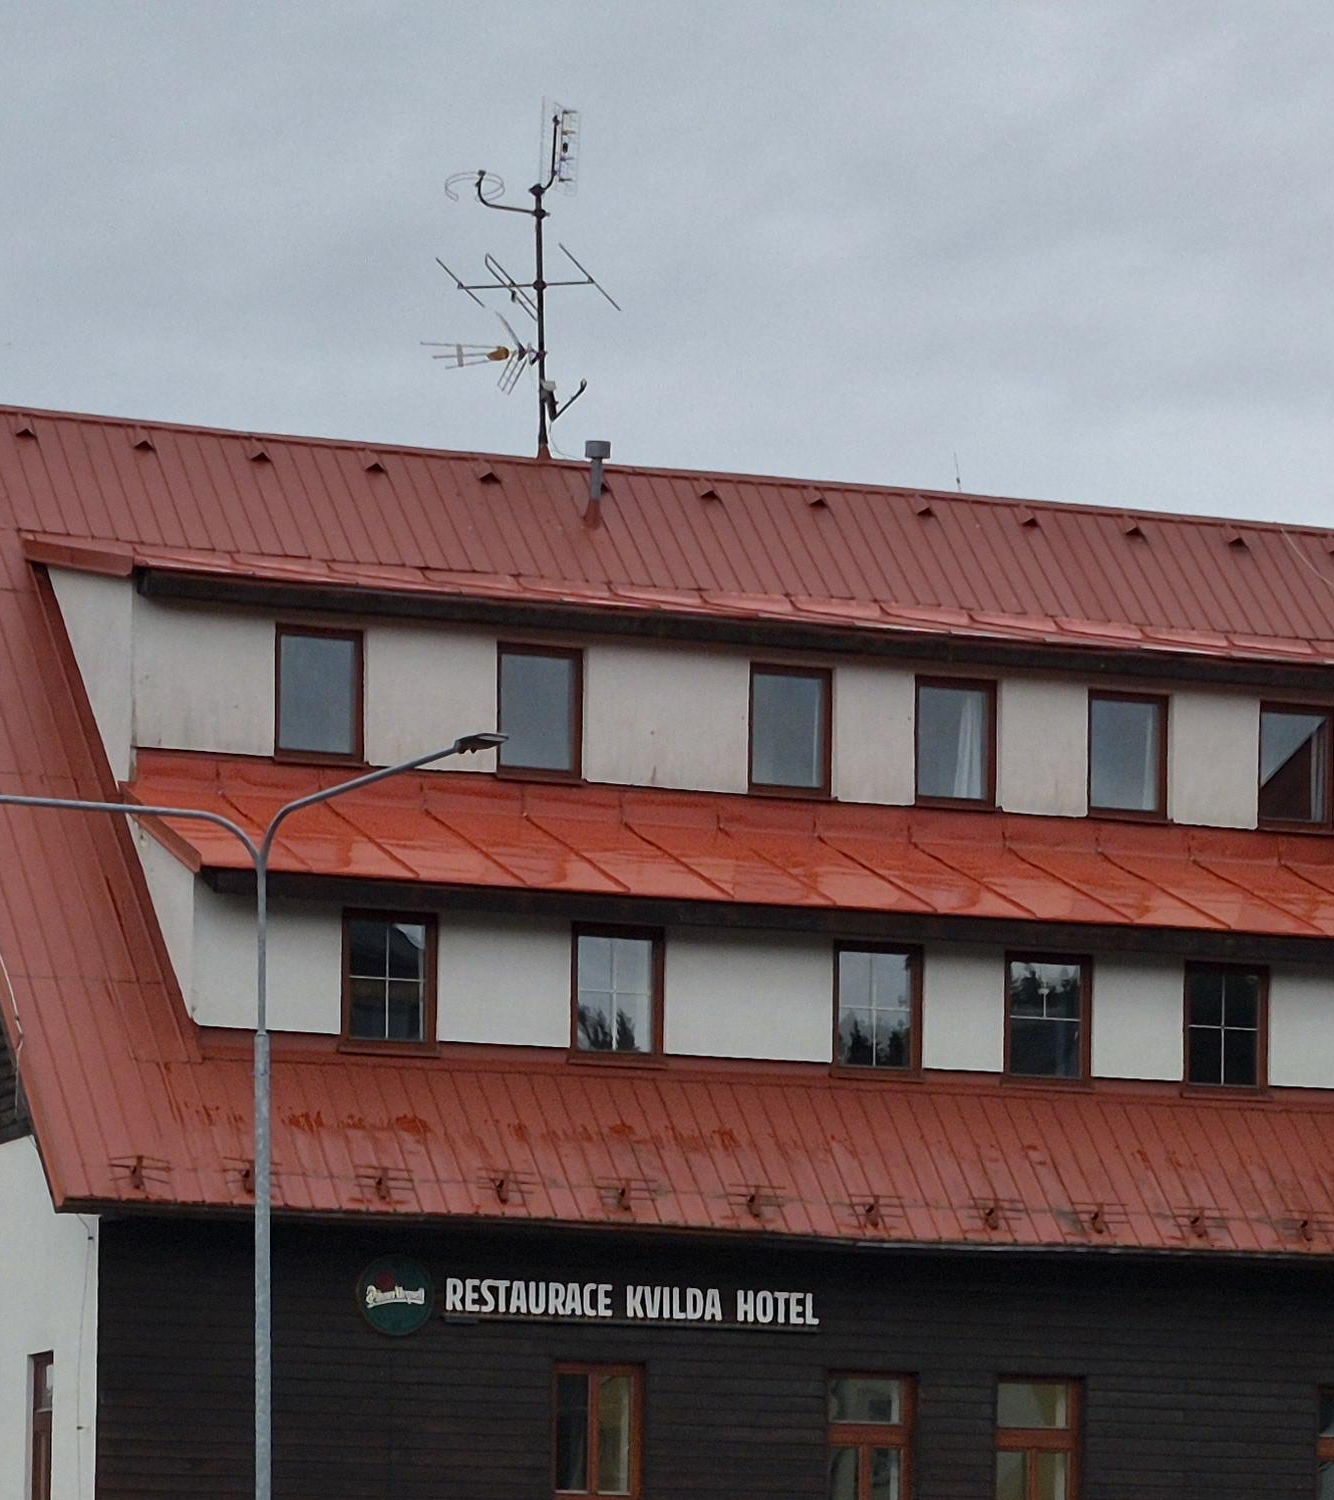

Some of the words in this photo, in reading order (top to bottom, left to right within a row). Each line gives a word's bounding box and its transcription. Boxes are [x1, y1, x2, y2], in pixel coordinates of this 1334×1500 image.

[446, 1278, 613, 1316] RESTAURACE
[626, 1285, 722, 1321] KVILDA
[736, 1289, 819, 1325] HOTEL
